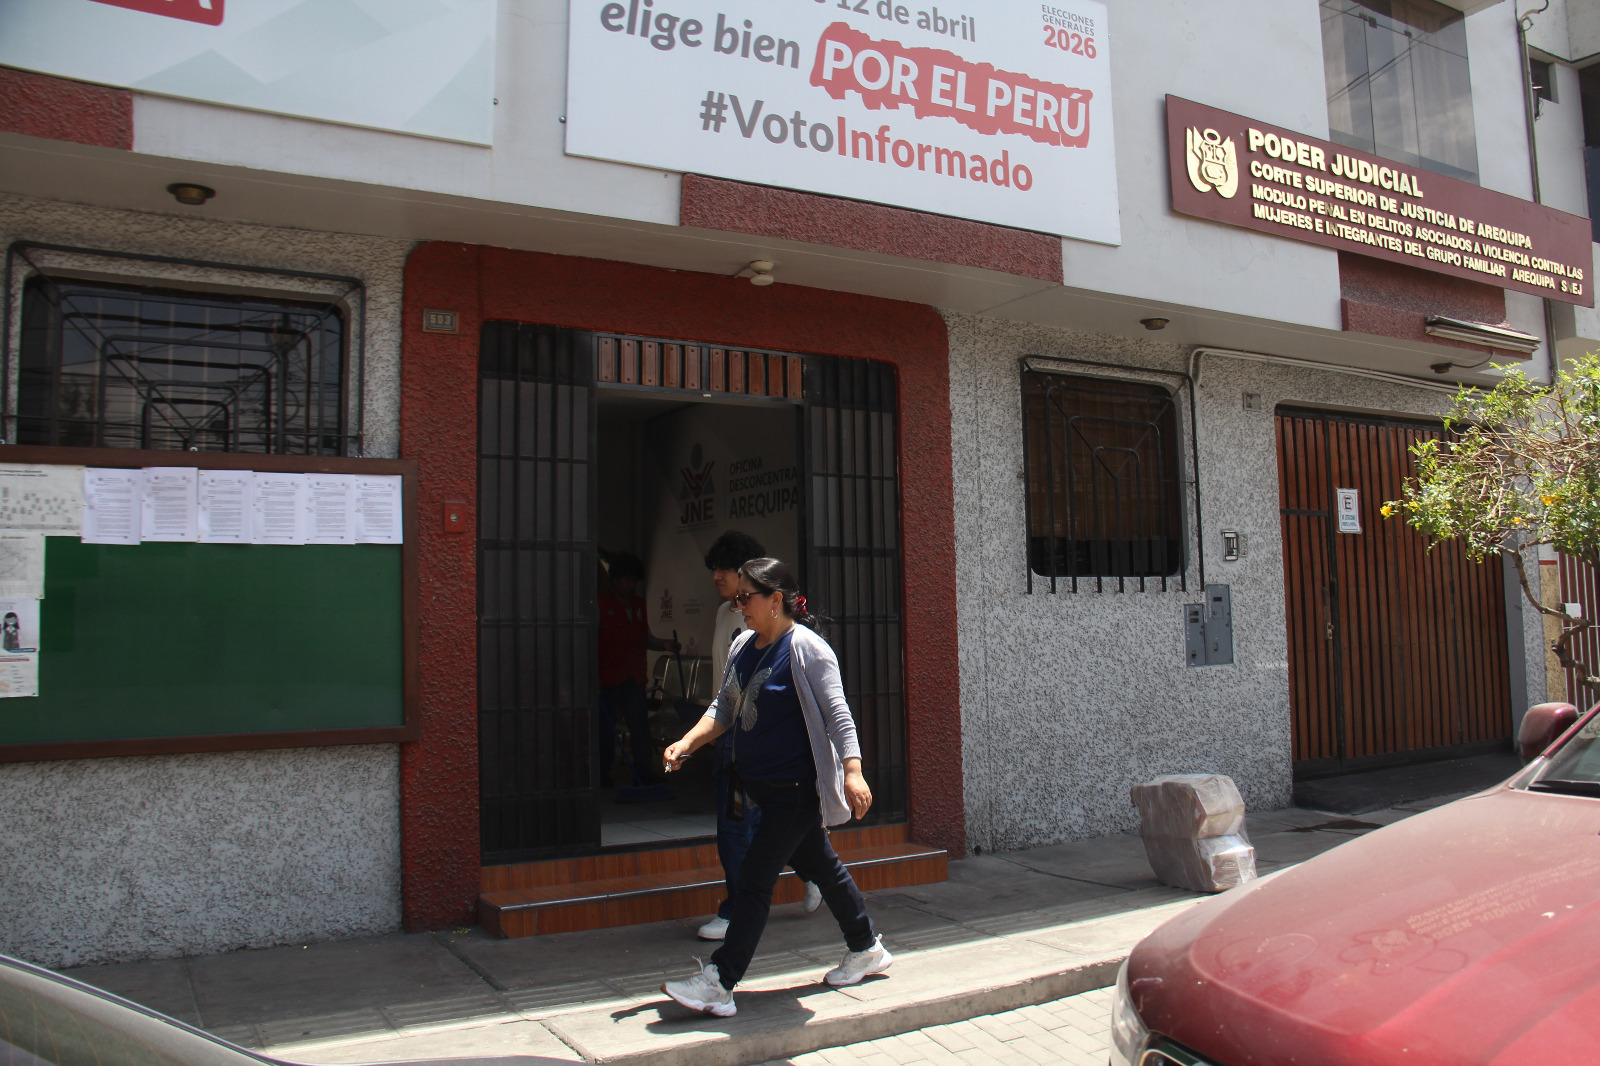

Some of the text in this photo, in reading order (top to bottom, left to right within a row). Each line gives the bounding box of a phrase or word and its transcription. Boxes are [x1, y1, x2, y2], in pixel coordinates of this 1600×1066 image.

[876, 0, 909, 25] de
[916, 7, 976, 43] abril
[1041, 4, 1095, 27] ELECCIONES
[1042, 14, 1095, 37] GENERALES
[1043, 25, 1097, 59] 2026
[600, 0, 1088, 139] elige bien POR EL PERÚ
[700, 90, 1033, 192] #VotoInformado
[1249, 127, 1423, 198] PODER JUDICIAL
[1251, 160, 1533, 250] CORTE SUPERIOR DE JUSTICIA DE AREQUIPA
[1252, 183, 1584, 281] MODULO PENAL EN DELITOS ASOCIADOS A VIOLENCIA CONTRA LAS
[1253, 202, 1313, 231] MUJERES
[1315, 218, 1323, 233] E
[1325, 221, 1402, 252] INTEGRANTES
[1404, 240, 1425, 258] DEL
[1426, 246, 1462, 267] GRUPO
[1463, 255, 1507, 278] FAMILIAR
[1512, 268, 1556, 290] AREQUIPA
[729, 456, 763, 476] OFICINA
[680, 498, 714, 524] JNE
[729, 486, 799, 520] AREQUIPA
